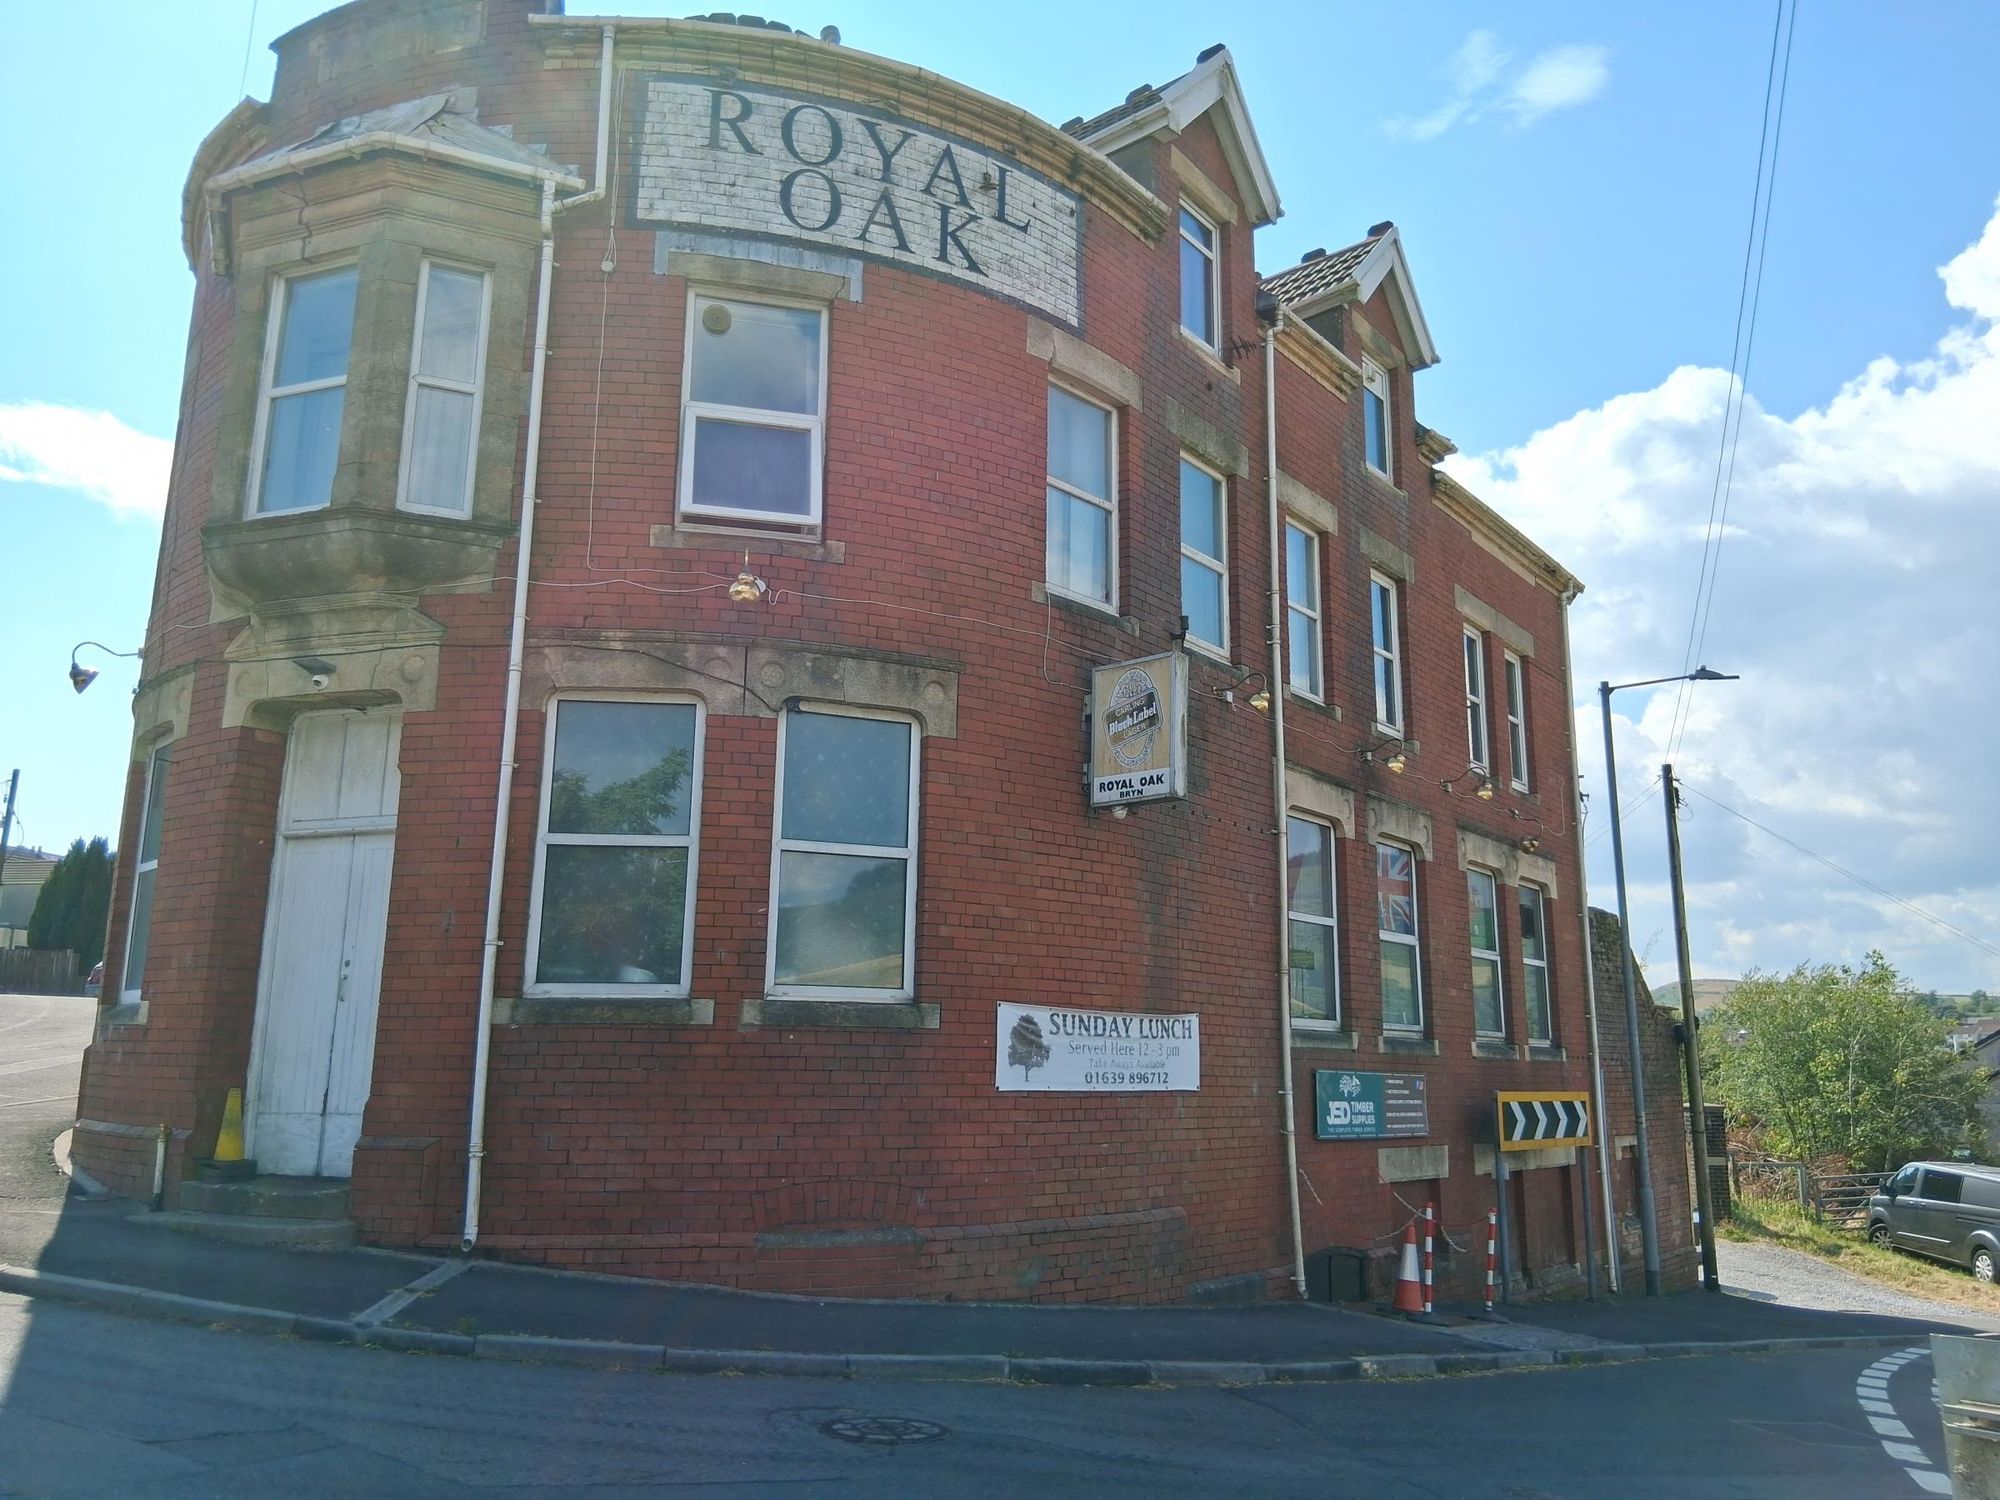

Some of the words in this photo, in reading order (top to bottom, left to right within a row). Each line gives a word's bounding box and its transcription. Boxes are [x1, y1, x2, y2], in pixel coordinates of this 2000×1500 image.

[703, 88, 1031, 234] ROYAL
[779, 168, 989, 277] OAK
[1115, 698, 1145, 717] CARLING
[1109, 714, 1133, 735] Black
[1133, 702, 1157, 725] Label
[1123, 722, 1146, 738] LAGER
[1099, 778, 1134, 792] ROYAL
[1139, 773, 1165, 787] OAK
[1119, 788, 1144, 799] BRYN
[1049, 1012, 1136, 1038] SUNDAY
[1139, 1018, 1192, 1040] LUNCH
[1068, 1039, 1106, 1055] Served
[1110, 1041, 1135, 1056] Here
[1138, 1042, 1149, 1056] 12
[1166, 1045, 1180, 1059] pm
[1089, 1058, 1108, 1068] Take
[1136, 1059, 1166, 1069] Available
[1085, 1071, 1125, 1084] 01639
[1129, 1072, 1169, 1084] 896712
[1326, 1101, 1351, 1125] JSD
[1350, 1101, 1374, 1113] TIMBER
[1351, 1114, 1376, 1125] SUPPLIES
